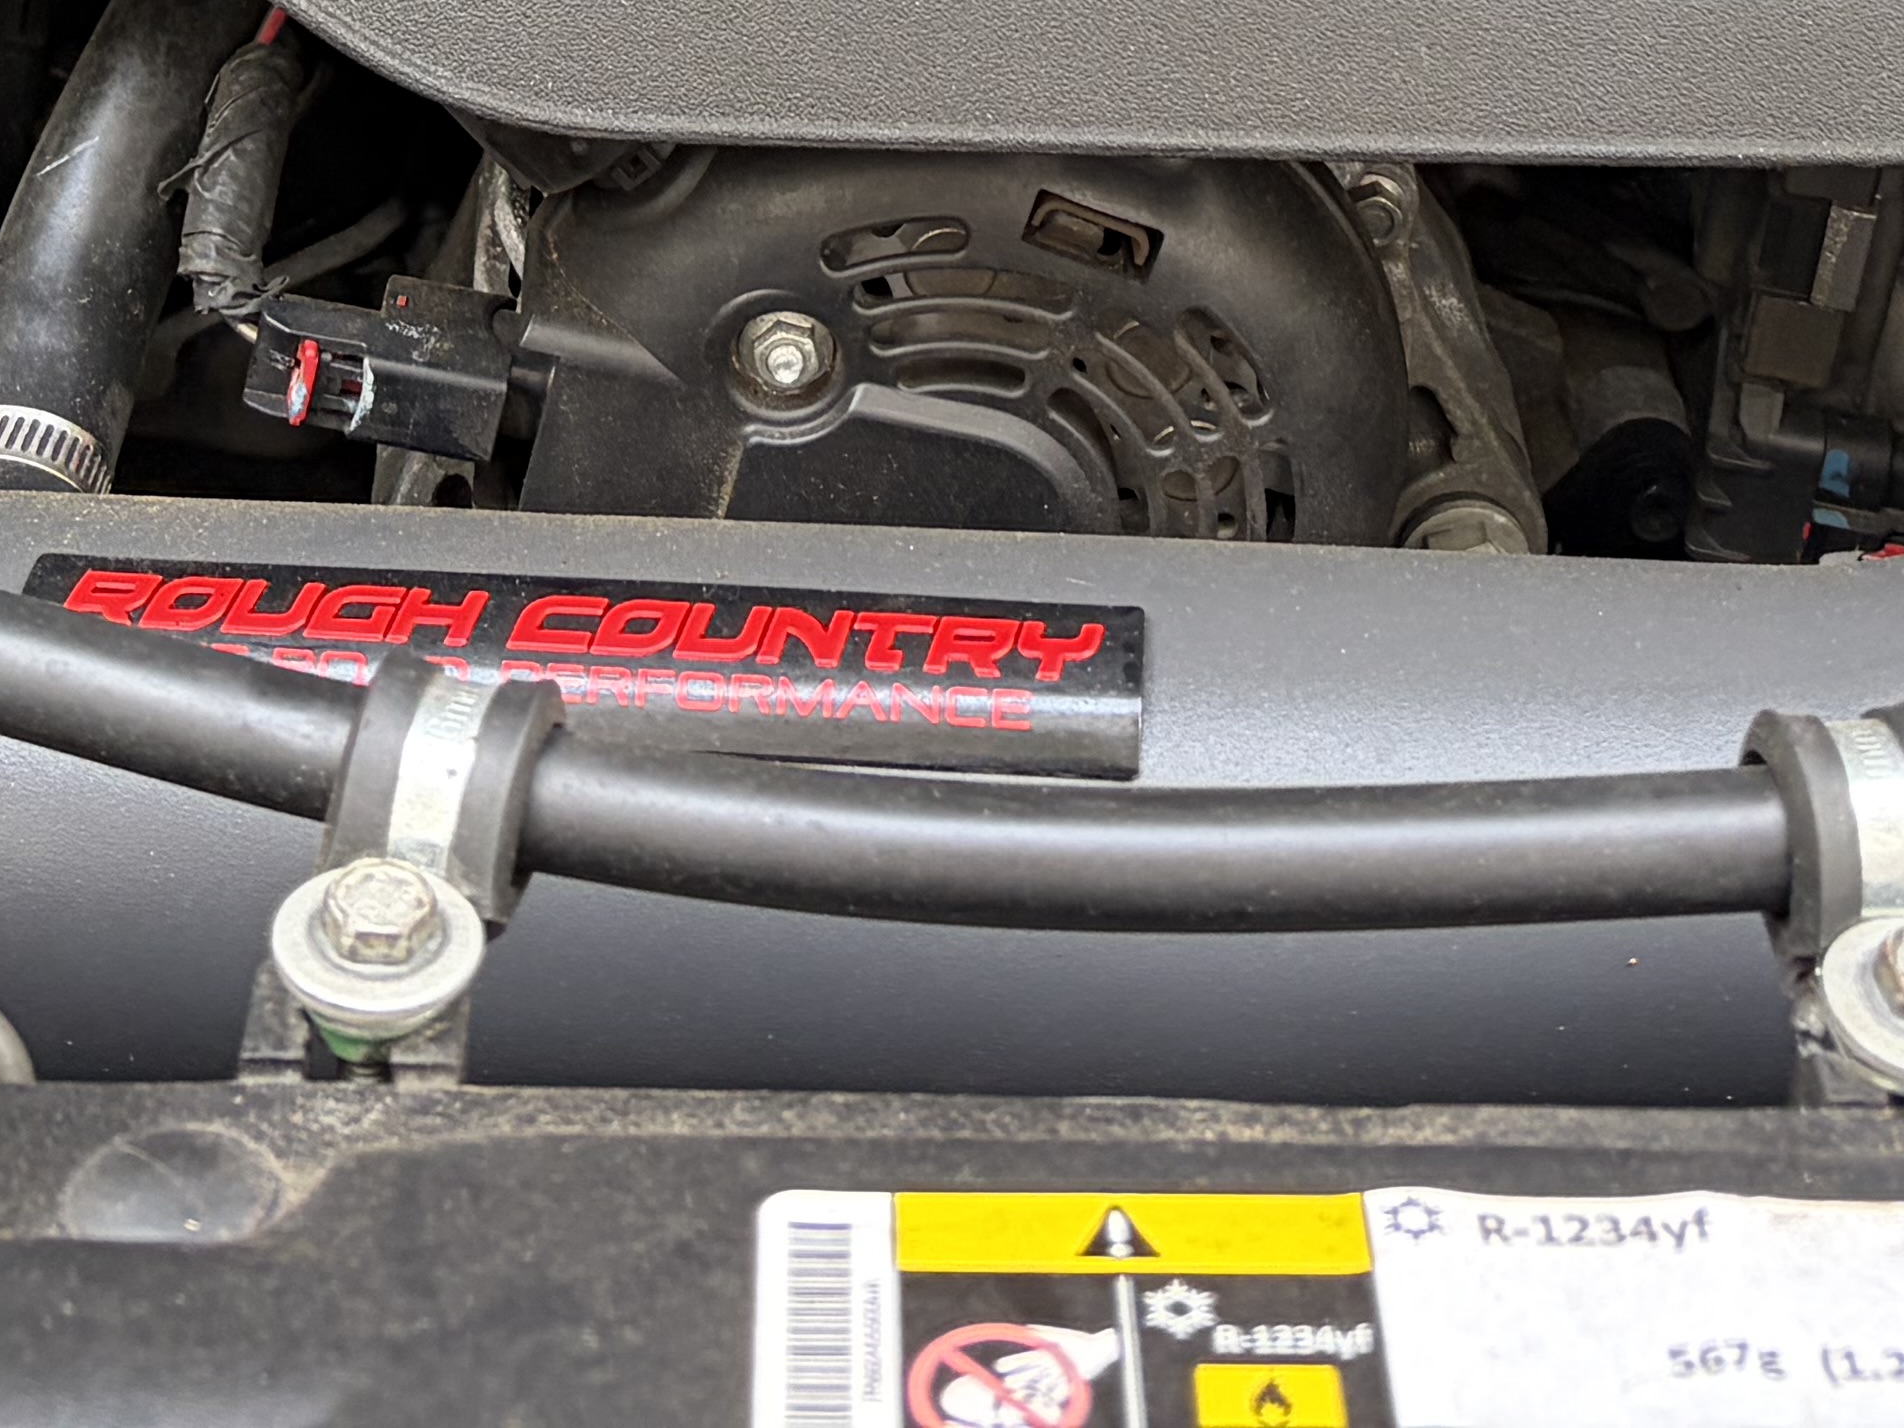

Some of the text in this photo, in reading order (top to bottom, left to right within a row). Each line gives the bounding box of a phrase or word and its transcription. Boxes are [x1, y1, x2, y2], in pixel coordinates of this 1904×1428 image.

[63, 570, 1105, 683] ROUGH COUNTRY
[1478, 1210, 1714, 1252] R-1234yf
[1213, 1322, 1376, 1361] R-1234yf
[1670, 1342, 1788, 1382] 567g
